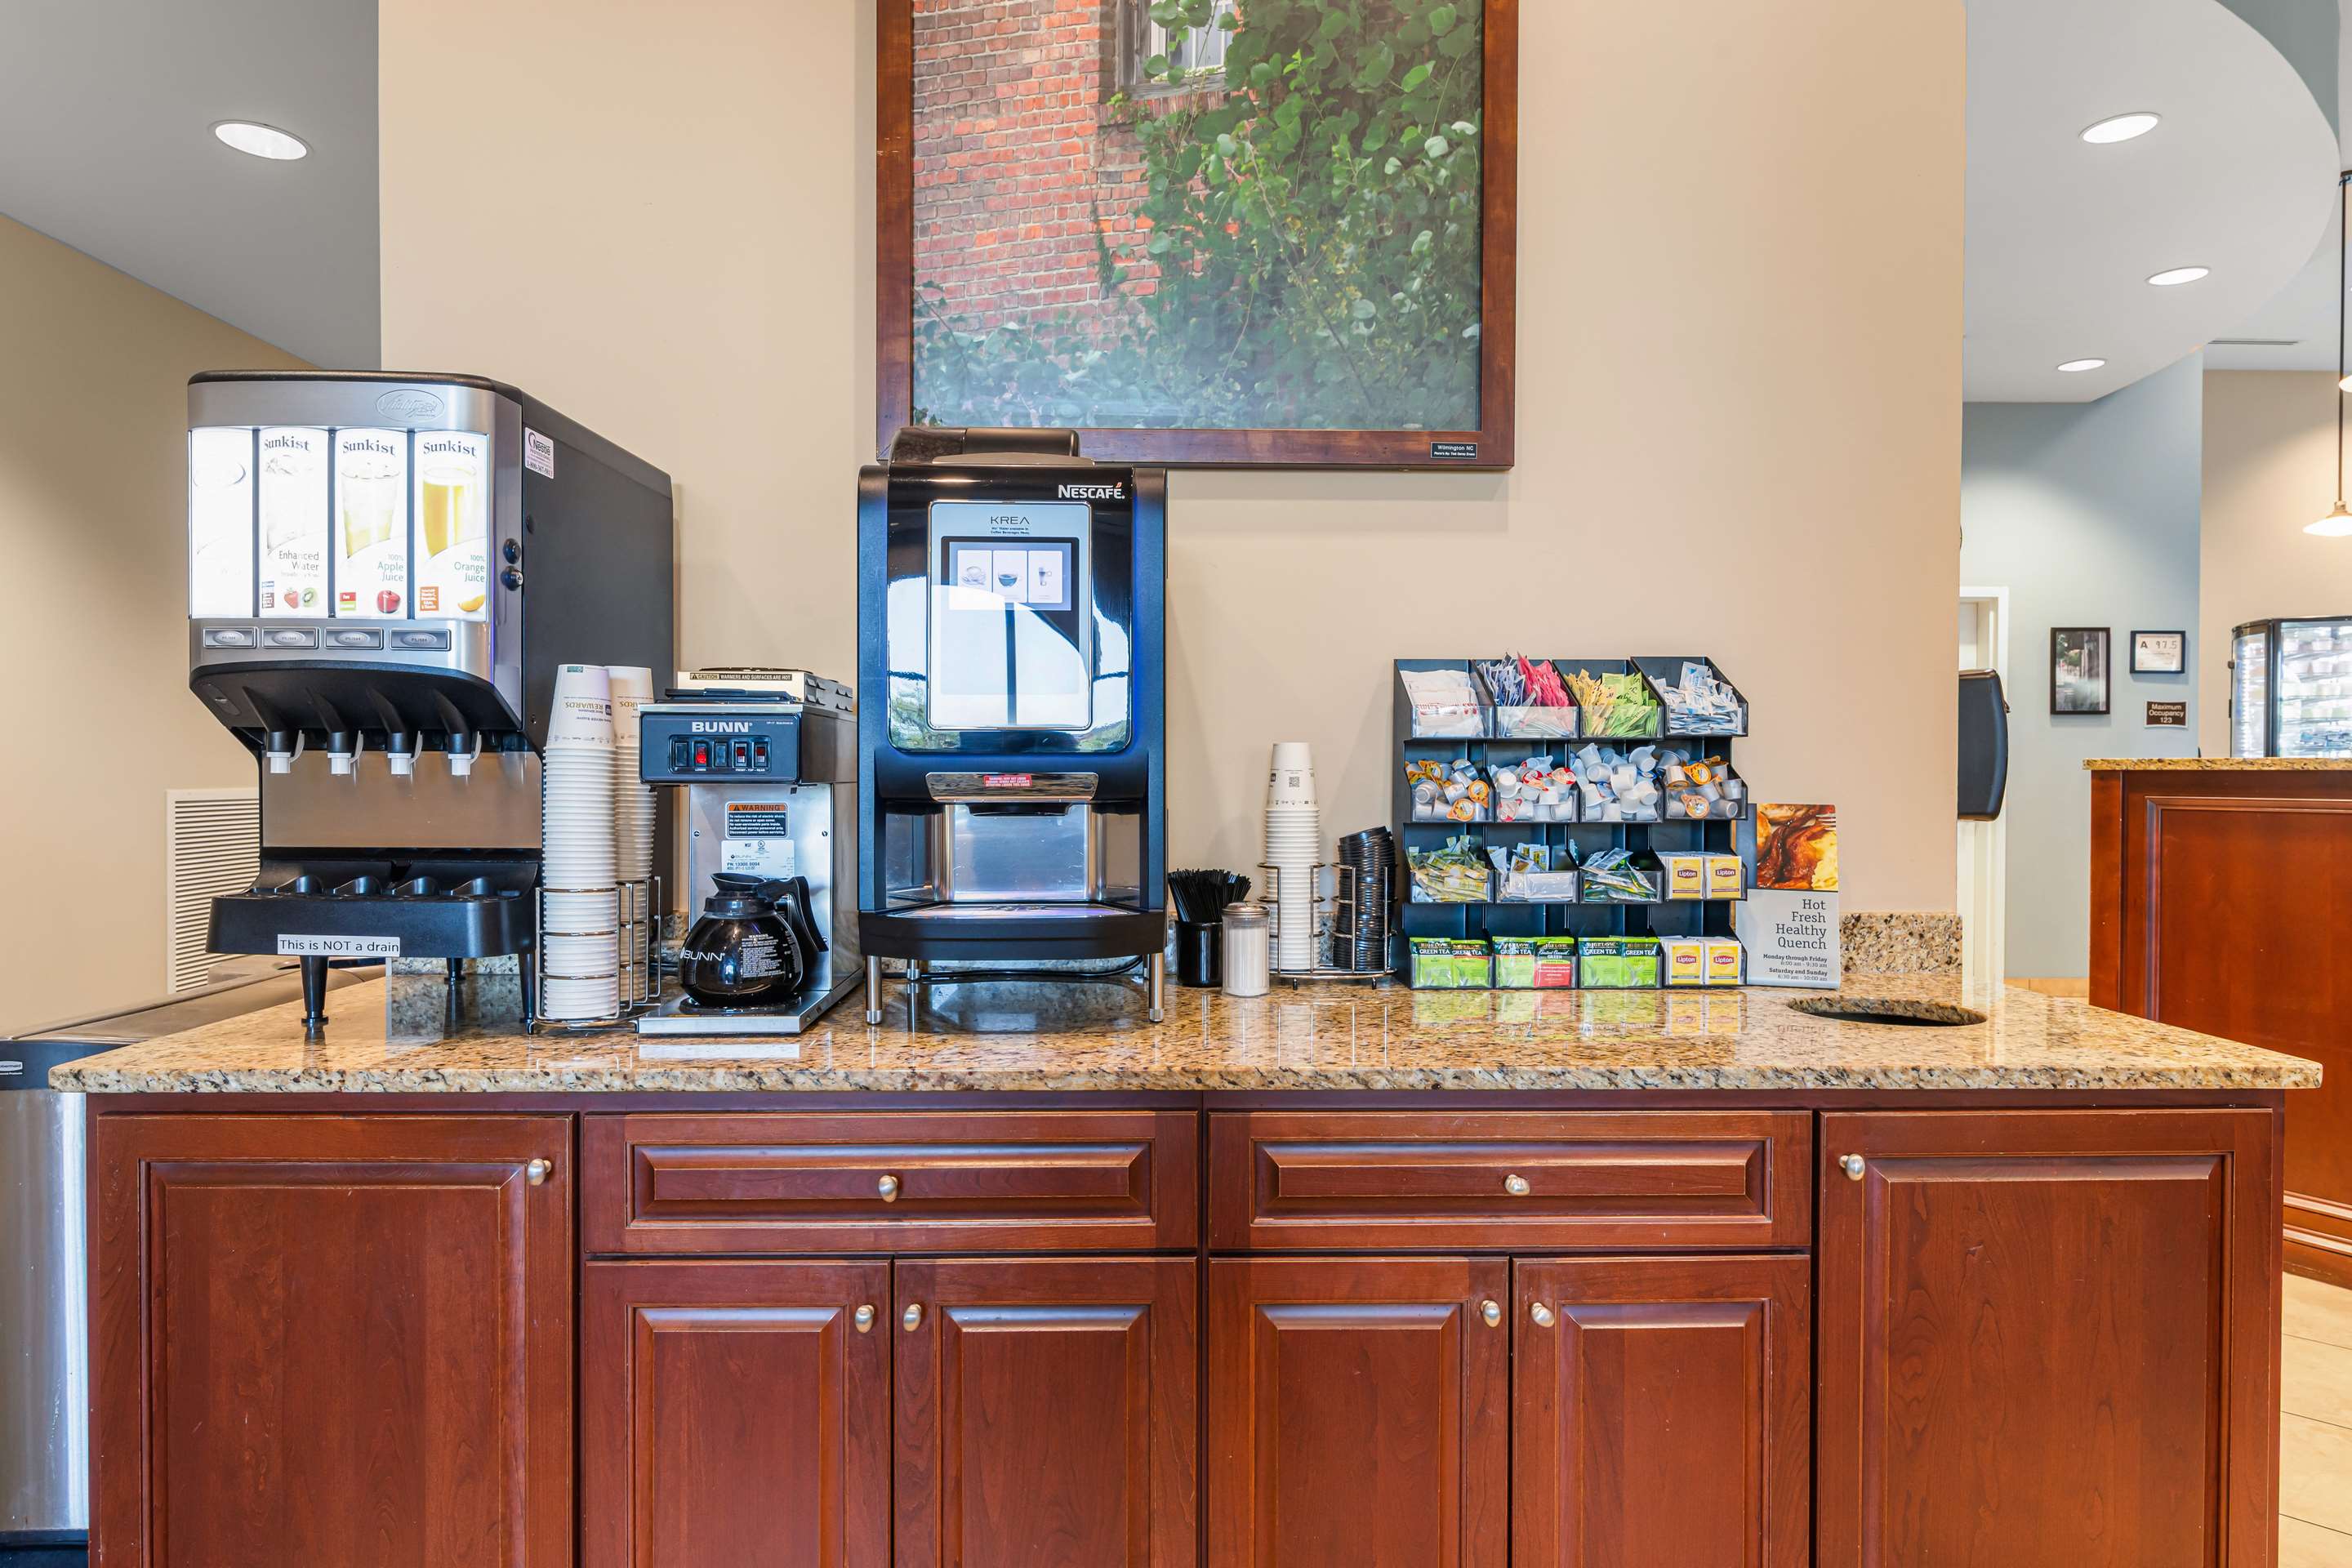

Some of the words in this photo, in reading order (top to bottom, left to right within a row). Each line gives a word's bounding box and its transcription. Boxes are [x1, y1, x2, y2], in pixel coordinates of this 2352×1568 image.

[264, 435, 310, 452] Sunkist
[342, 439, 396, 457] Sunkist
[423, 440, 477, 458] Sunkist
[991, 516, 1030, 524] KREA
[278, 550, 319, 561] Enhanced
[292, 561, 319, 571] Water
[377, 561, 404, 572] Apple
[454, 561, 485, 574] Orange
[381, 572, 404, 581] Juice
[464, 572, 485, 582] Juice
[2140, 640, 2148, 648] A
[565, 702, 604, 710] REWARDS
[692, 721, 749, 733] BUNN
[1802, 899, 1826, 910] Hot
[1792, 911, 1826, 923] Fresh
[1775, 924, 1827, 938] Healthy
[280, 940, 305, 950] This
[309, 940, 318, 950] is
[323, 941, 351, 951] NOT
[355, 943, 363, 951] a
[368, 942, 399, 952] drain
[1778, 937, 1827, 950] Quench
